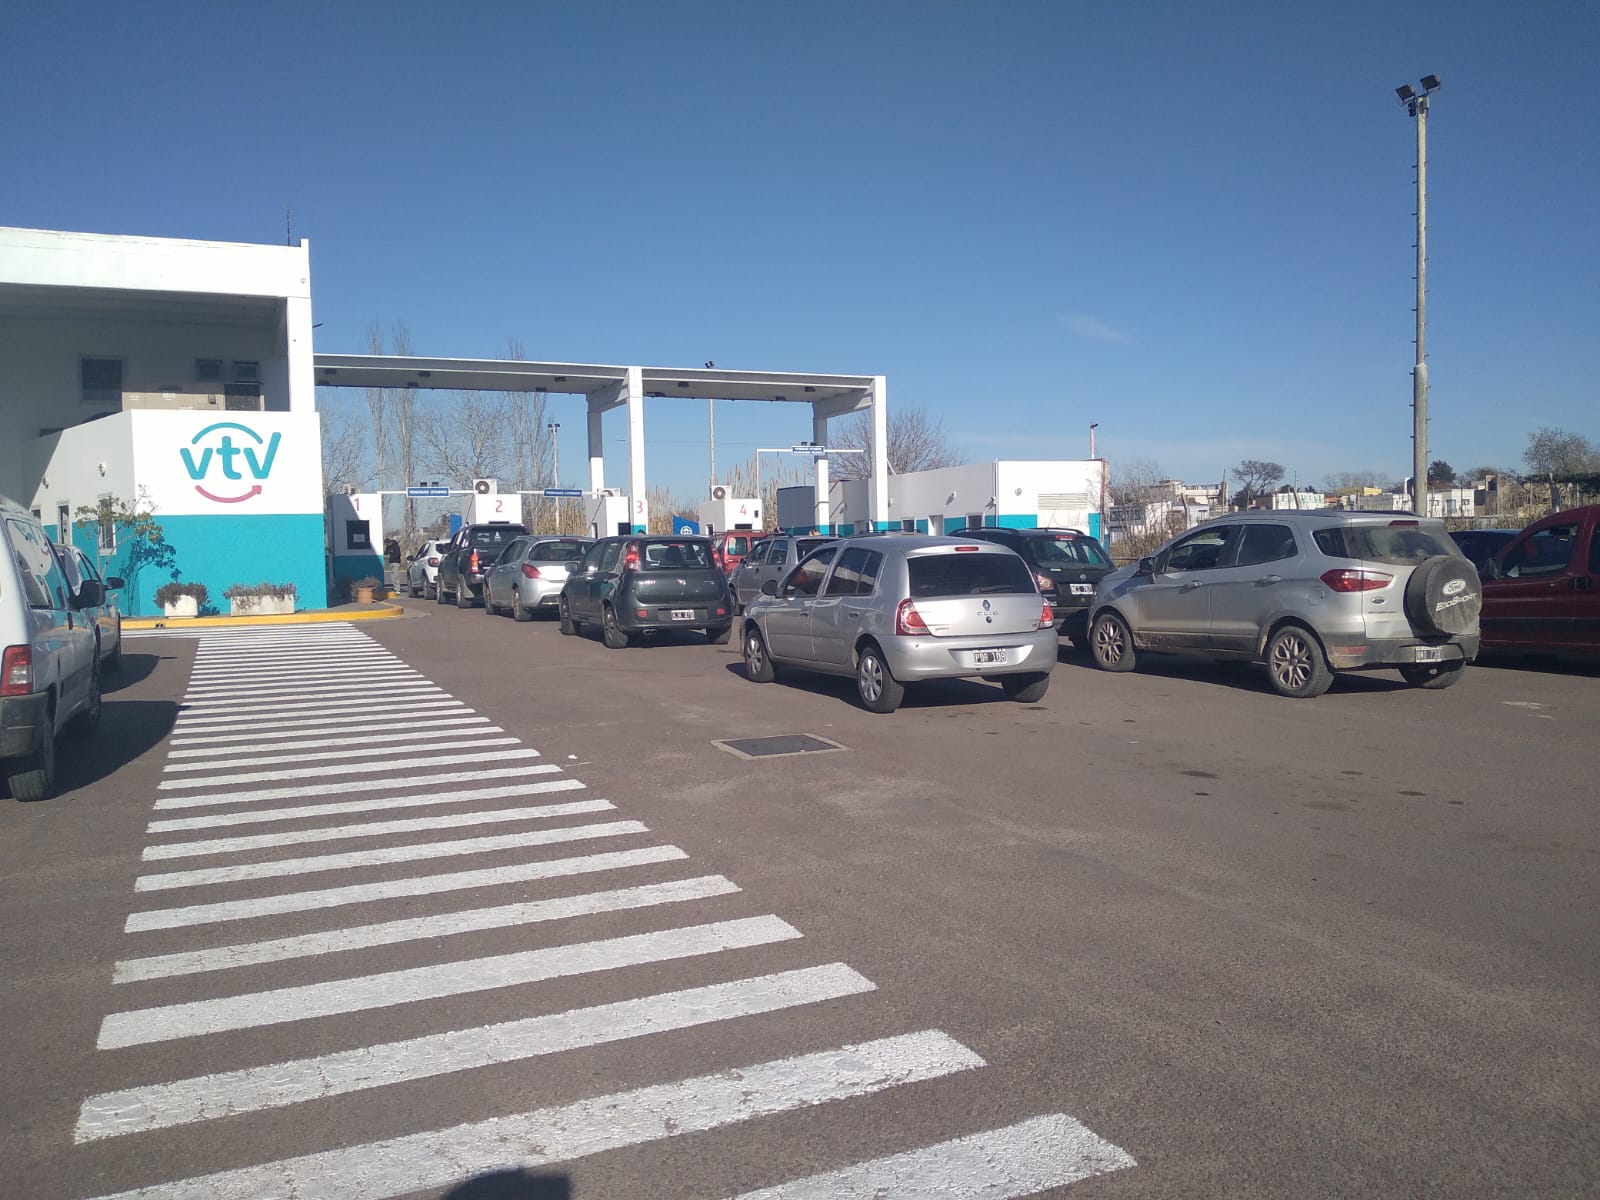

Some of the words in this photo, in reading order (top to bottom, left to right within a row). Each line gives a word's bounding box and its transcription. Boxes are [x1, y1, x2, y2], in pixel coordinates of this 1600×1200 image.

[353, 499, 360, 511] 1
[495, 500, 503, 513] 2
[637, 501, 644, 513] 3
[740, 504, 747, 516] 4
